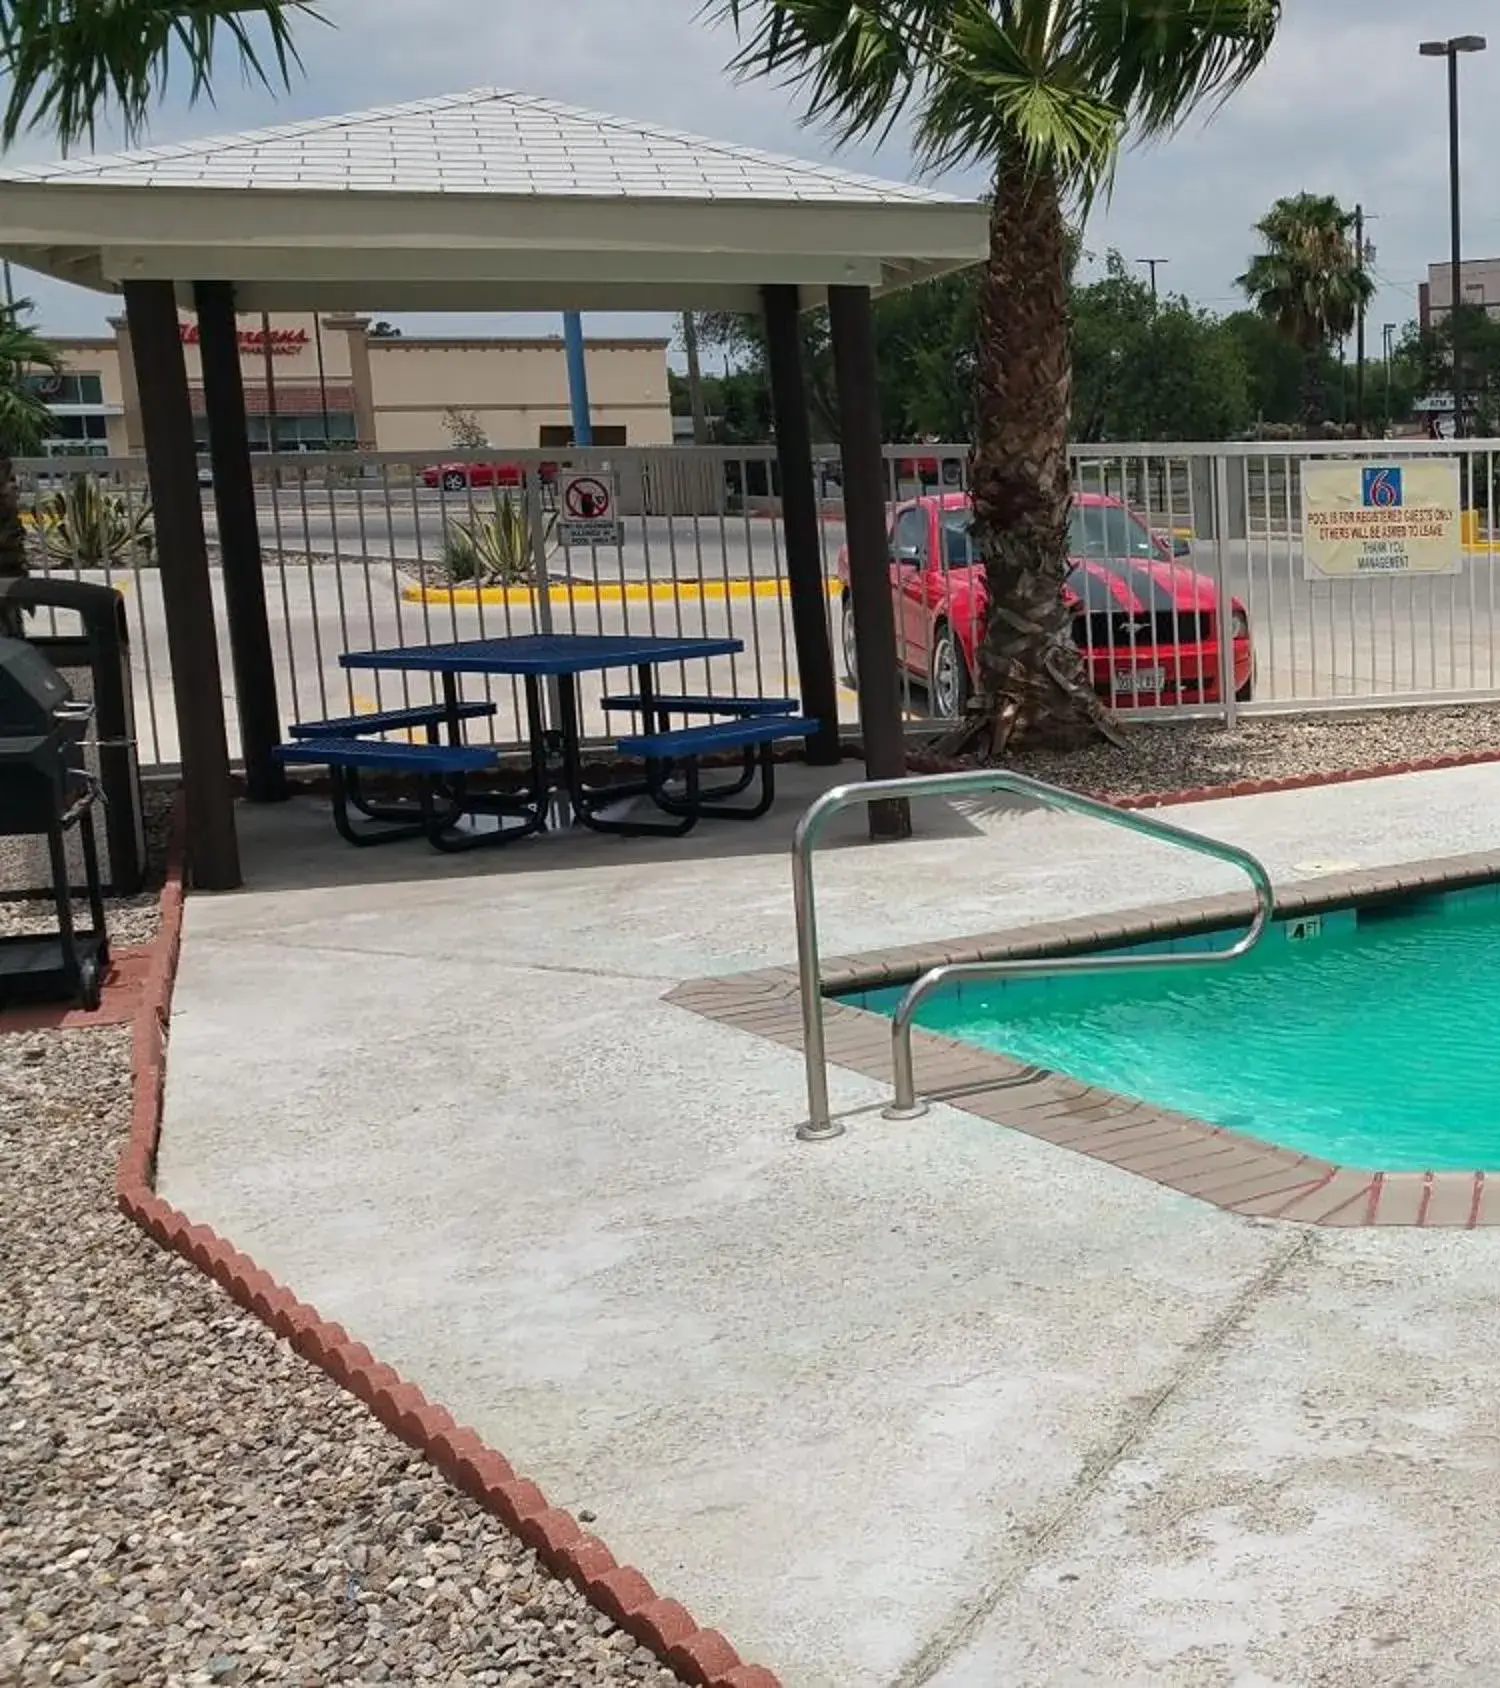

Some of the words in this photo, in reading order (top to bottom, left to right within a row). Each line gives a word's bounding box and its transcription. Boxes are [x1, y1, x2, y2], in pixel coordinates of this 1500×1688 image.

[240, 345, 303, 355] PHAMACY
[1370, 469, 1396, 507] 6
[1308, 512, 1329, 525] POOL
[1339, 511, 1355, 523] FOR
[1356, 510, 1402, 523] REGISTERED
[1404, 509, 1432, 522] GUESTS
[1433, 508, 1453, 521] ONLY
[1320, 527, 1350, 541] OTHERS
[1351, 527, 1369, 539] WILL
[1370, 526, 1380, 538] BE
[1381, 525, 1406, 538] ASKED
[1408, 525, 1418, 537] TO
[1362, 541, 1387, 553] THANK
[1389, 541, 1405, 553] YOU
[1357, 555, 1409, 569] MANAGEMENT
[1292, 923, 1305, 939] 4
